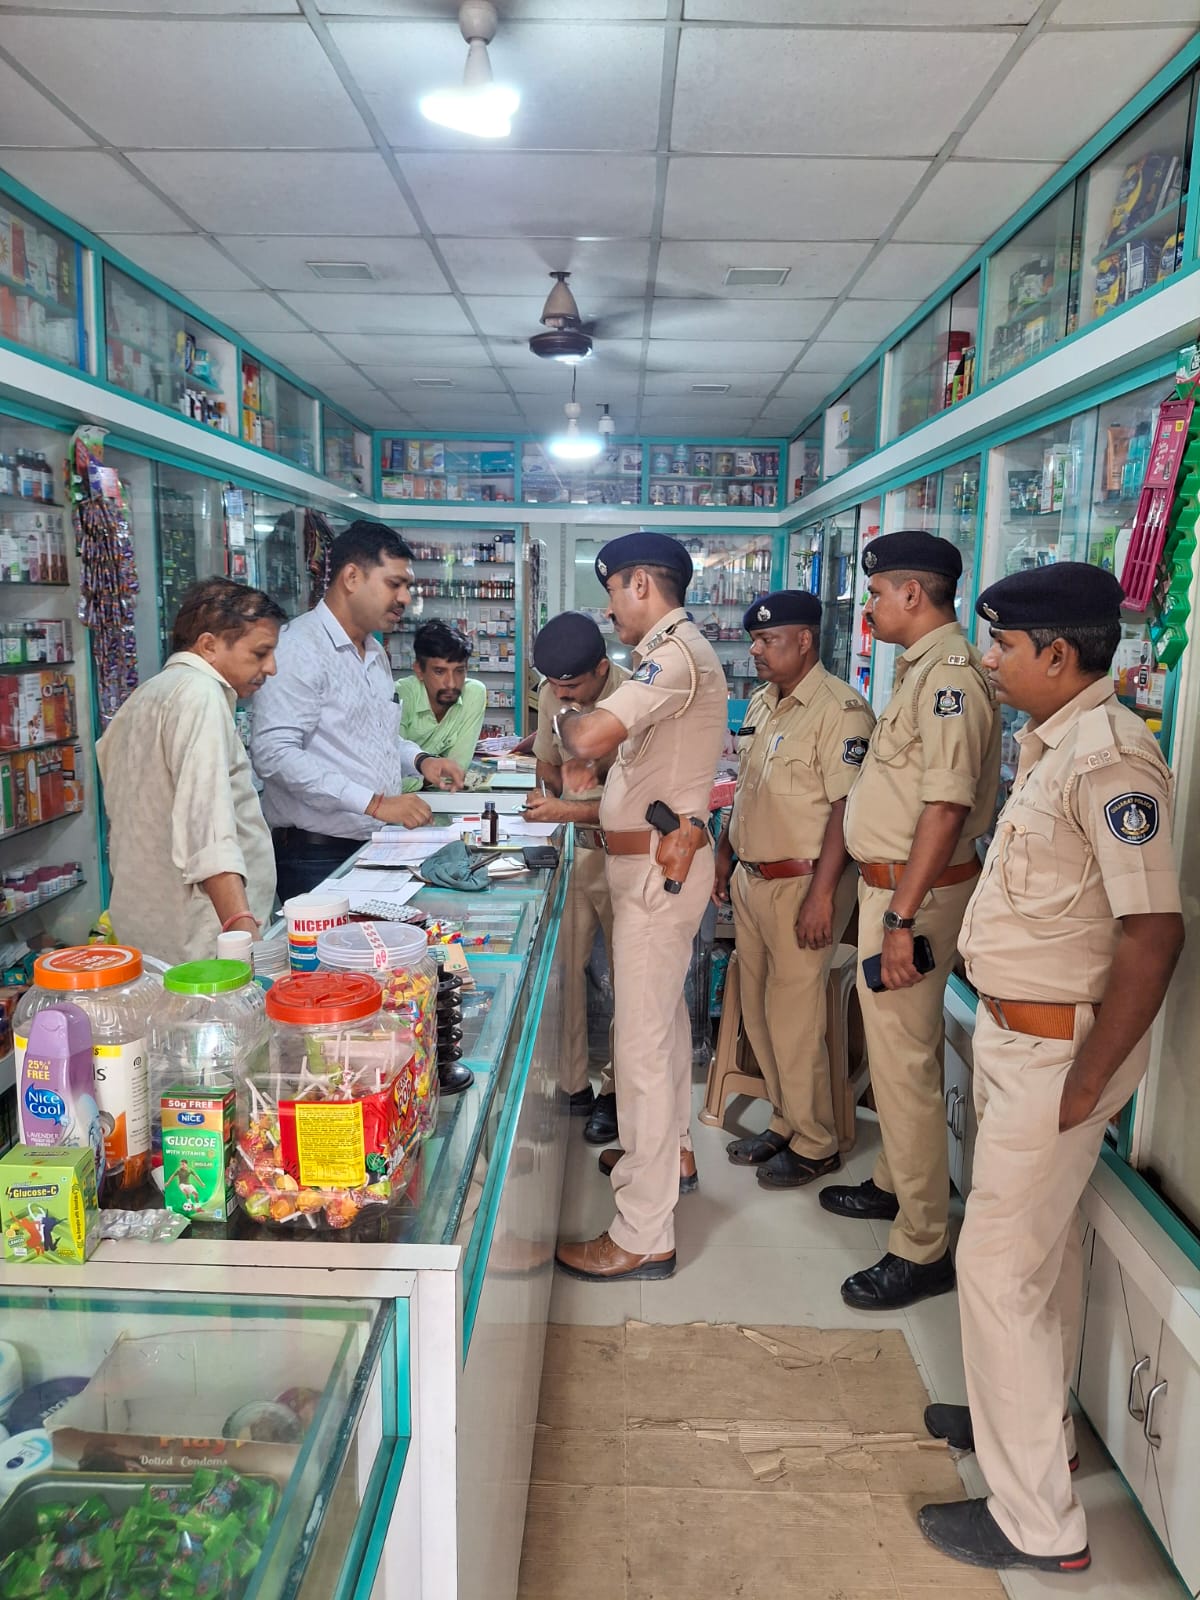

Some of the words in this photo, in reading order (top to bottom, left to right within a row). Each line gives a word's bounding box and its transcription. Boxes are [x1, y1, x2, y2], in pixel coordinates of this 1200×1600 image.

[27, 1069, 50, 1080] FREE
[28, 1091, 60, 1104] Nice
[29, 1102, 61, 1115] Cool
[189, 1101, 214, 1109] FREE
[167, 1136, 217, 1148] GLUCOSE
[13, 1186, 57, 1199] Glucose-C
[140, 1455, 174, 1466] Dotted
[180, 1455, 229, 1468] Condoms
